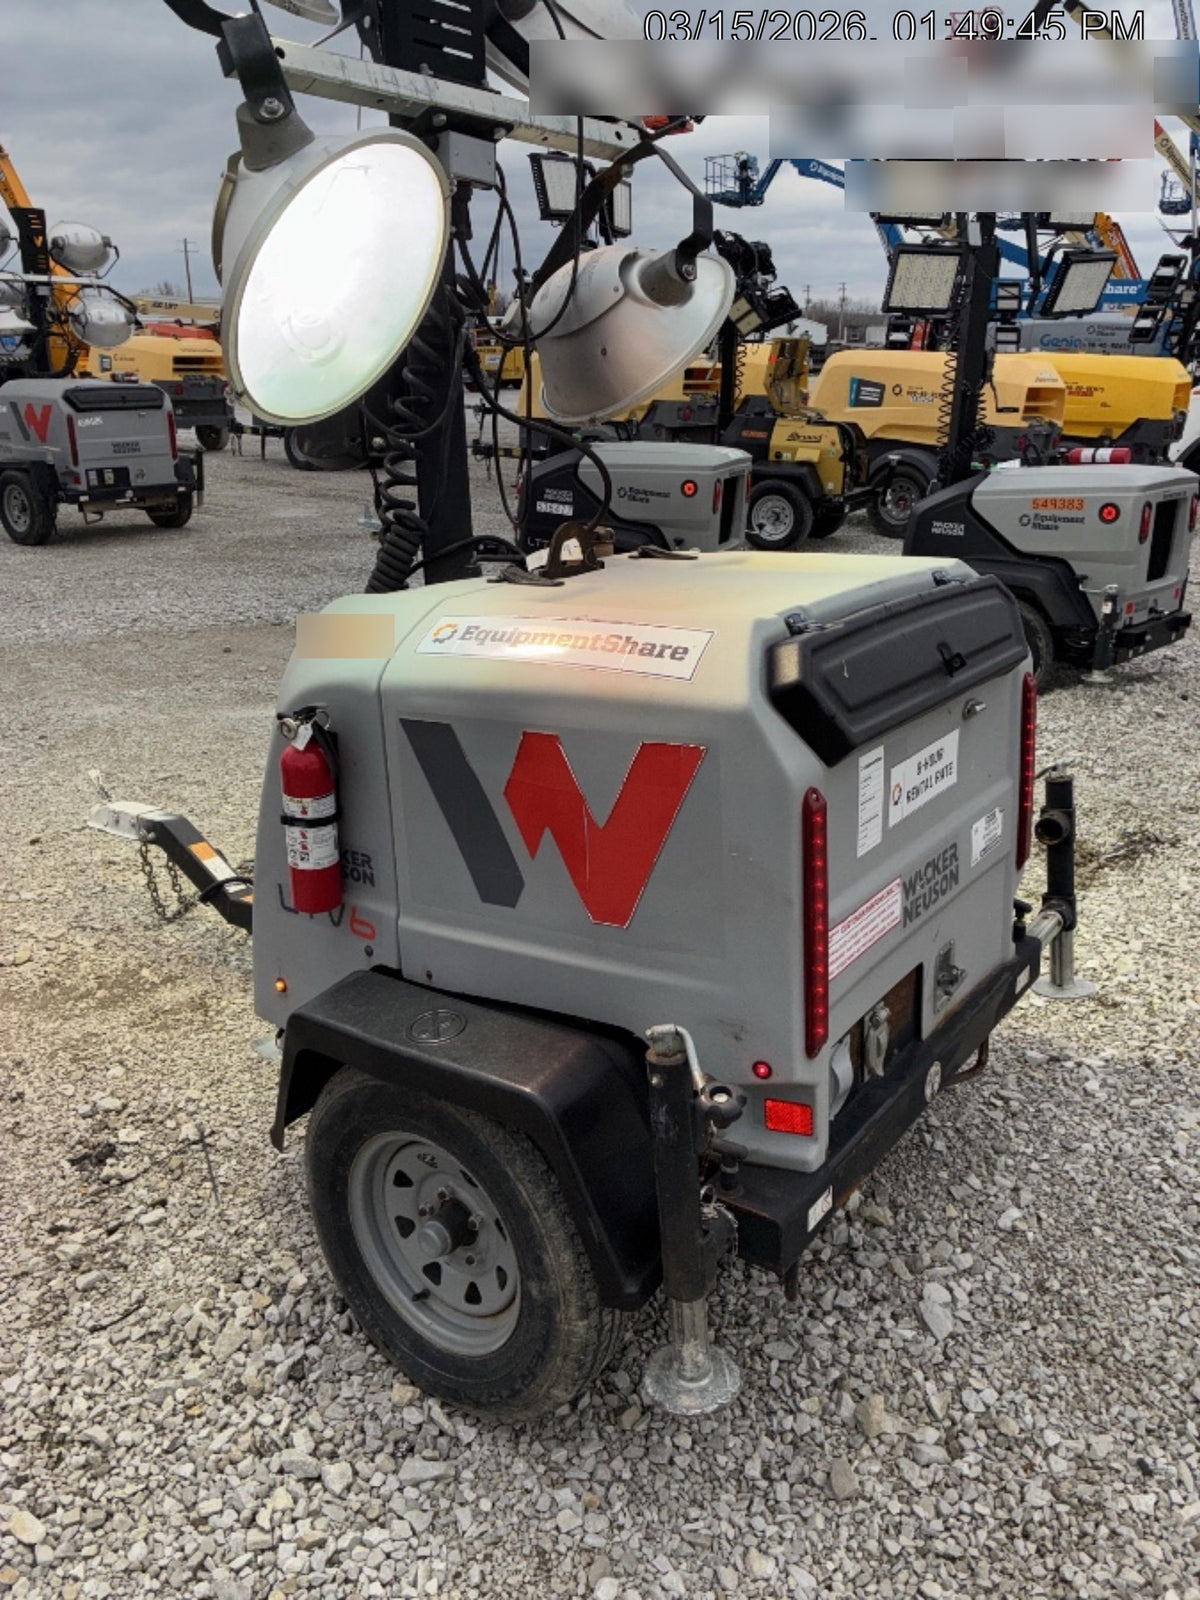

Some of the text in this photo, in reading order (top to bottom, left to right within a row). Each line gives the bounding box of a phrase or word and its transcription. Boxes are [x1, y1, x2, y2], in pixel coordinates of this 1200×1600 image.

[459, 625, 689, 661] EquipmentShare
[341, 851, 374, 870] KER
[341, 868, 376, 888] SON
[903, 842, 959, 900] WACKER
[903, 864, 959, 928] NEUSON
